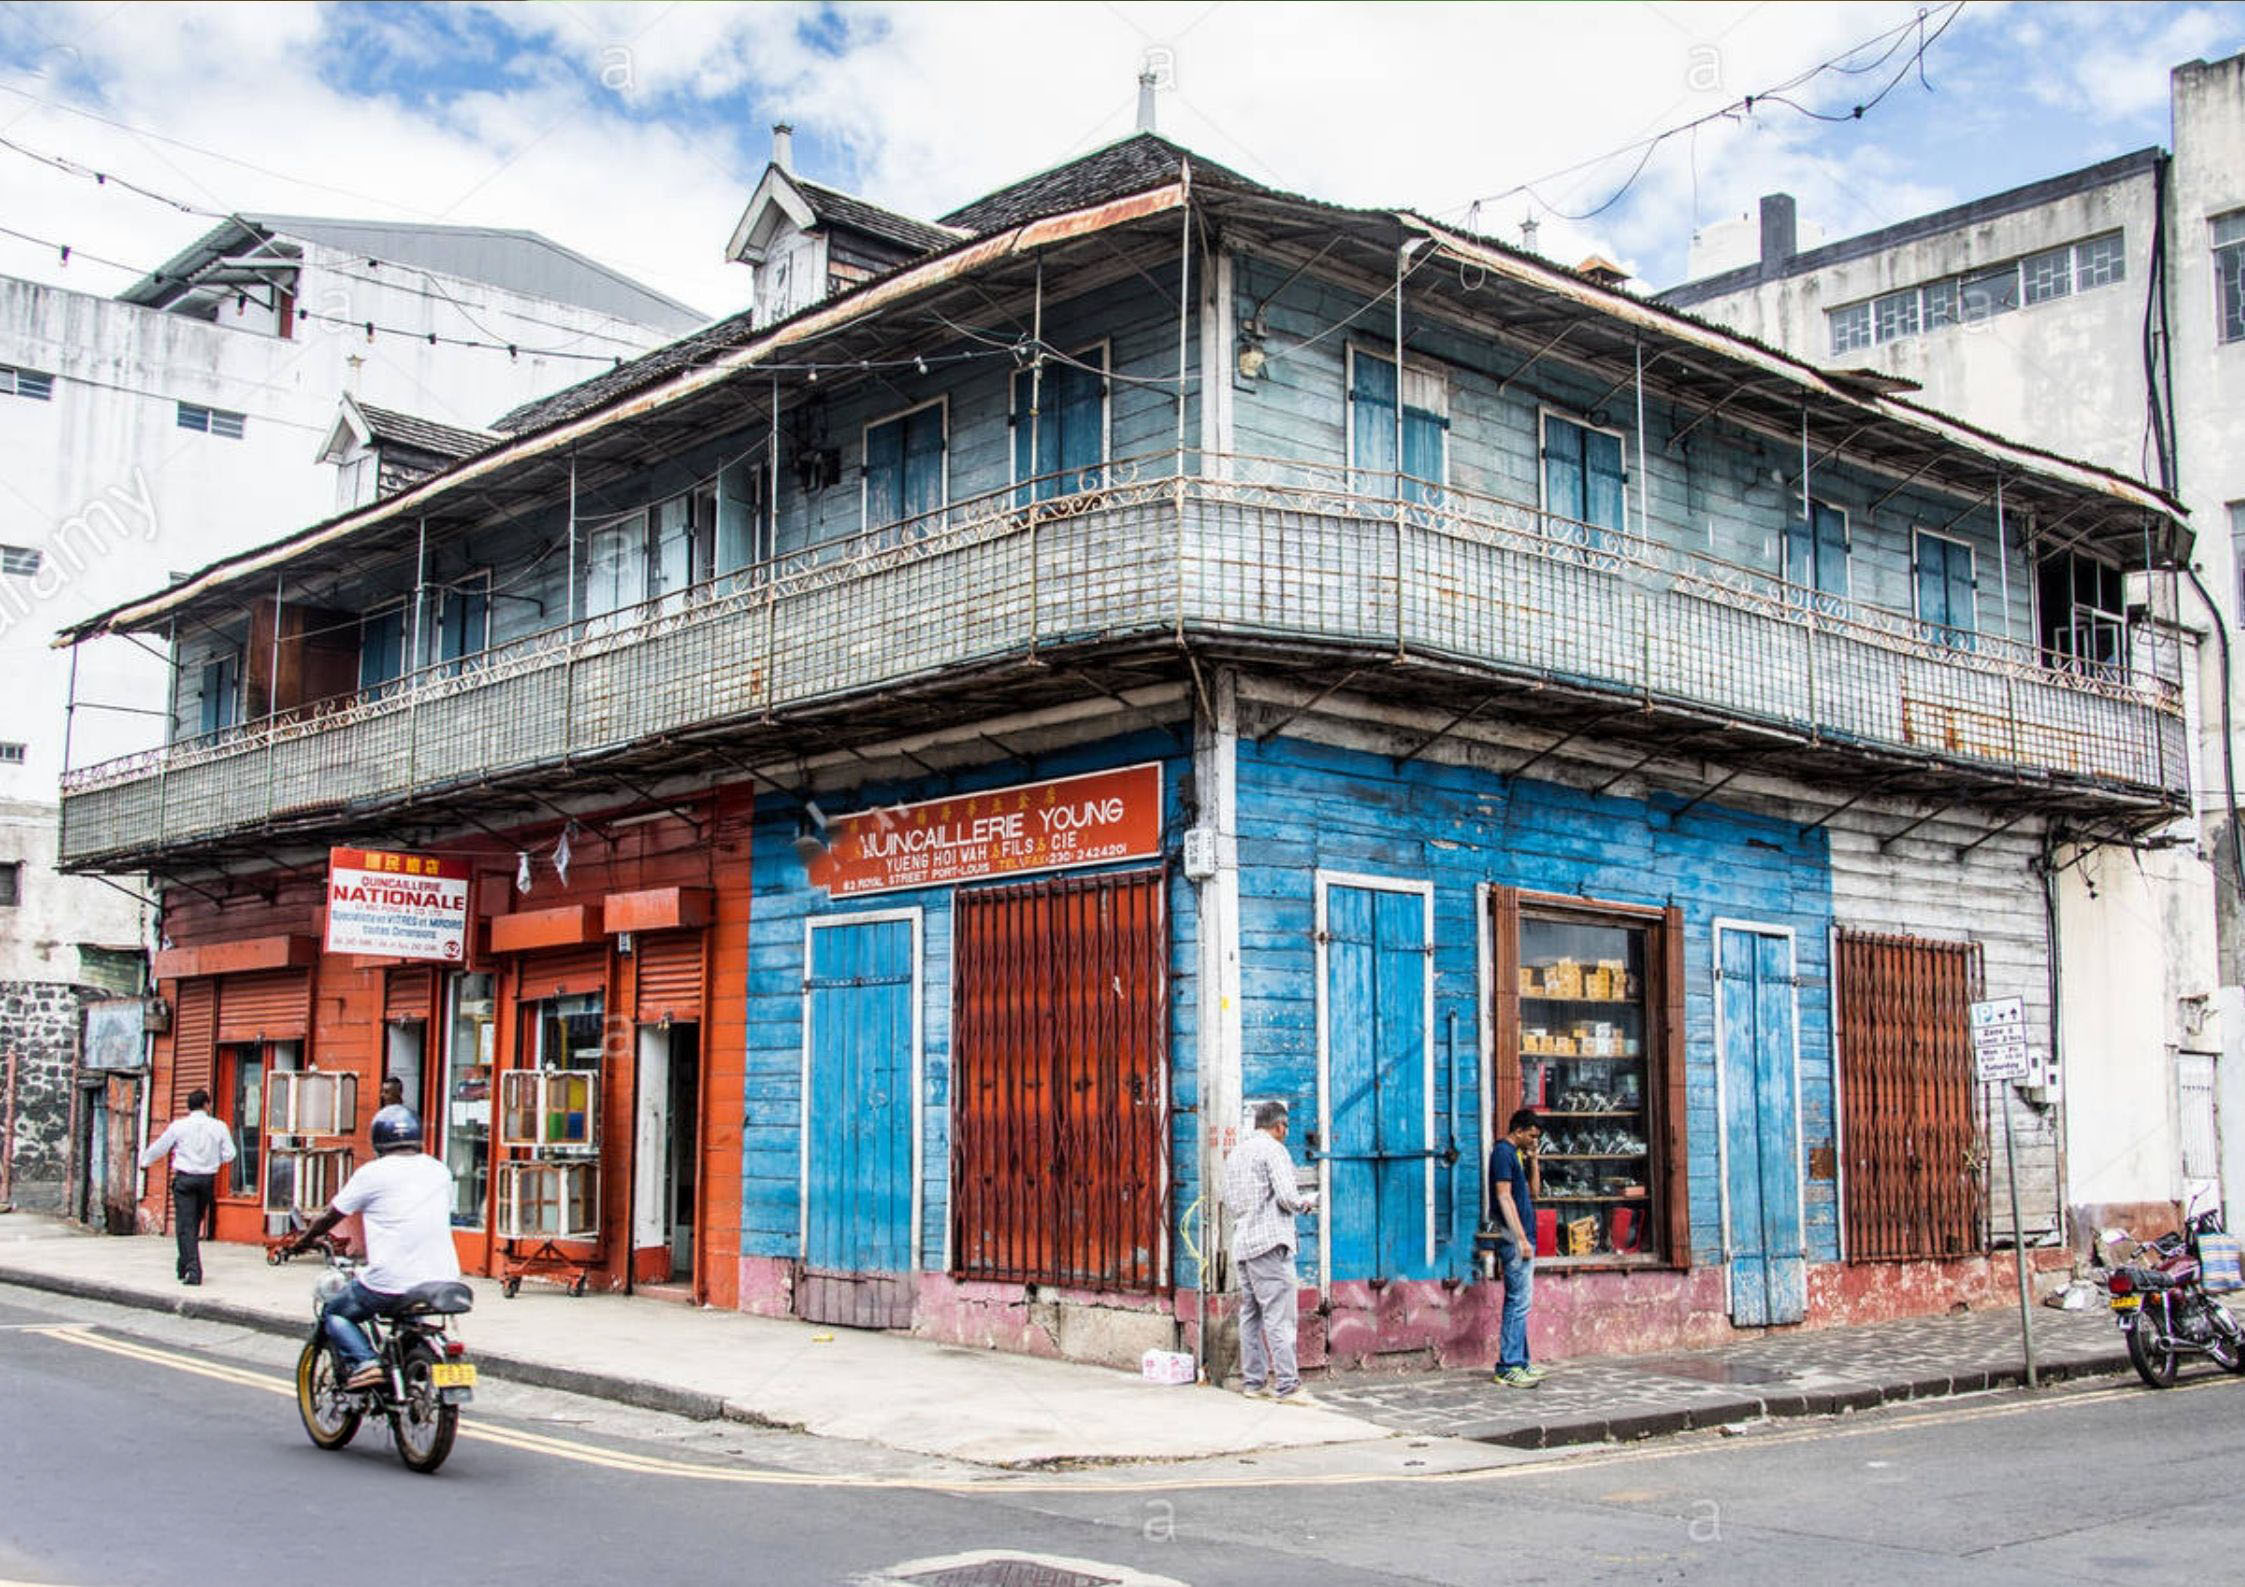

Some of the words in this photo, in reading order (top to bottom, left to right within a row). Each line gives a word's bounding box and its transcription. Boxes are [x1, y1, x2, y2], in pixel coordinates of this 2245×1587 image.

[1038, 798, 1124, 833] YOUNG
[959, 844, 987, 863] WAH
[1002, 838, 1034, 857] FILS
[1051, 831, 1077, 850] CIE
[361, 876, 442, 893] QUINCAILLERIE
[888, 871, 927, 886] STREET
[333, 885, 464, 911] NATIONALE
